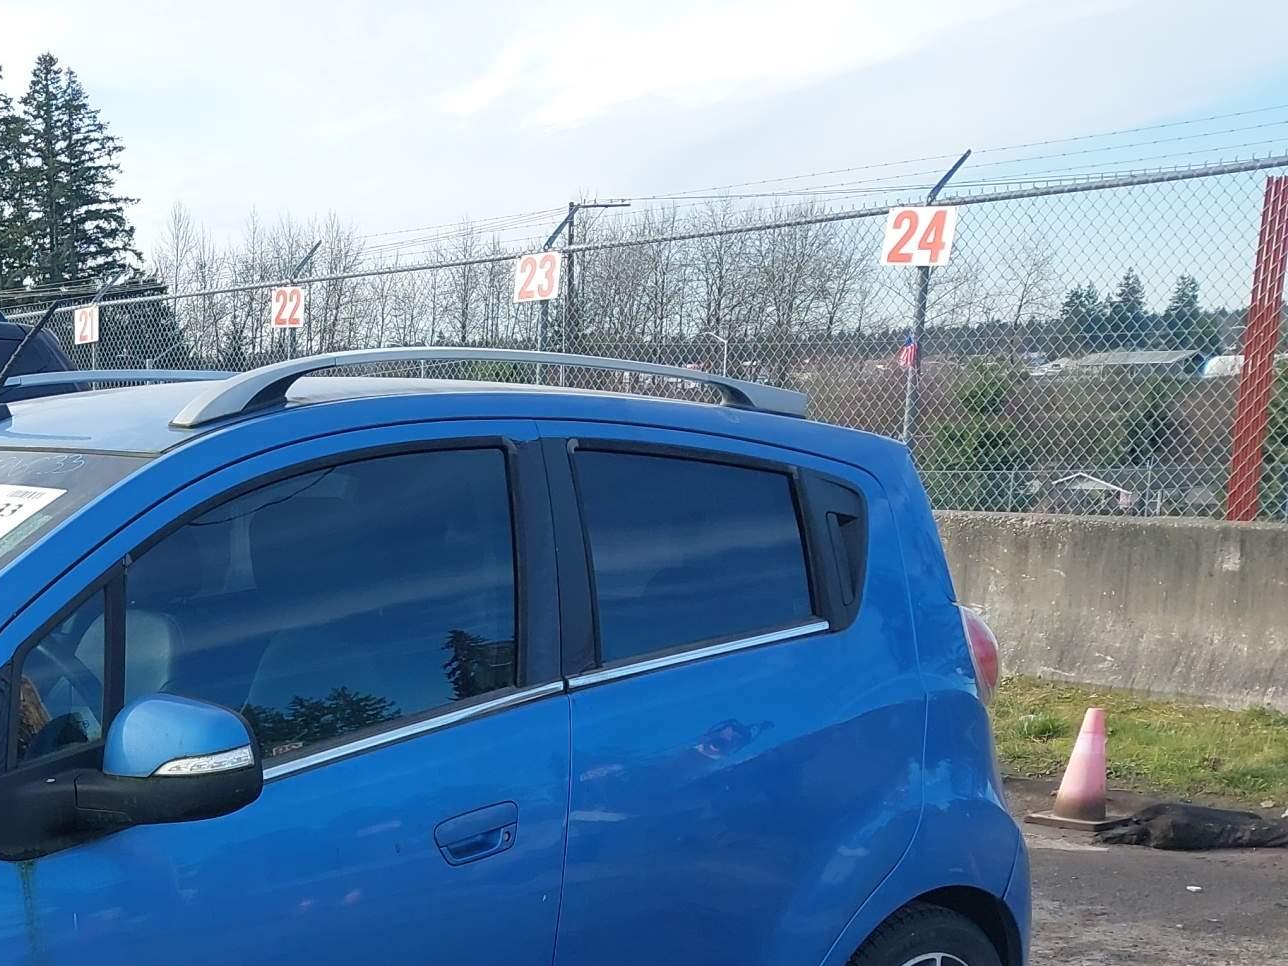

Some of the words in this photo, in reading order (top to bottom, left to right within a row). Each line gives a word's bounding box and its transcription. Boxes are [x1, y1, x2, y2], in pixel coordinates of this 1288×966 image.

[887, 209, 948, 263] 24
[518, 254, 556, 299] 23
[79, 310, 94, 342] 21
[275, 288, 301, 325] 22
